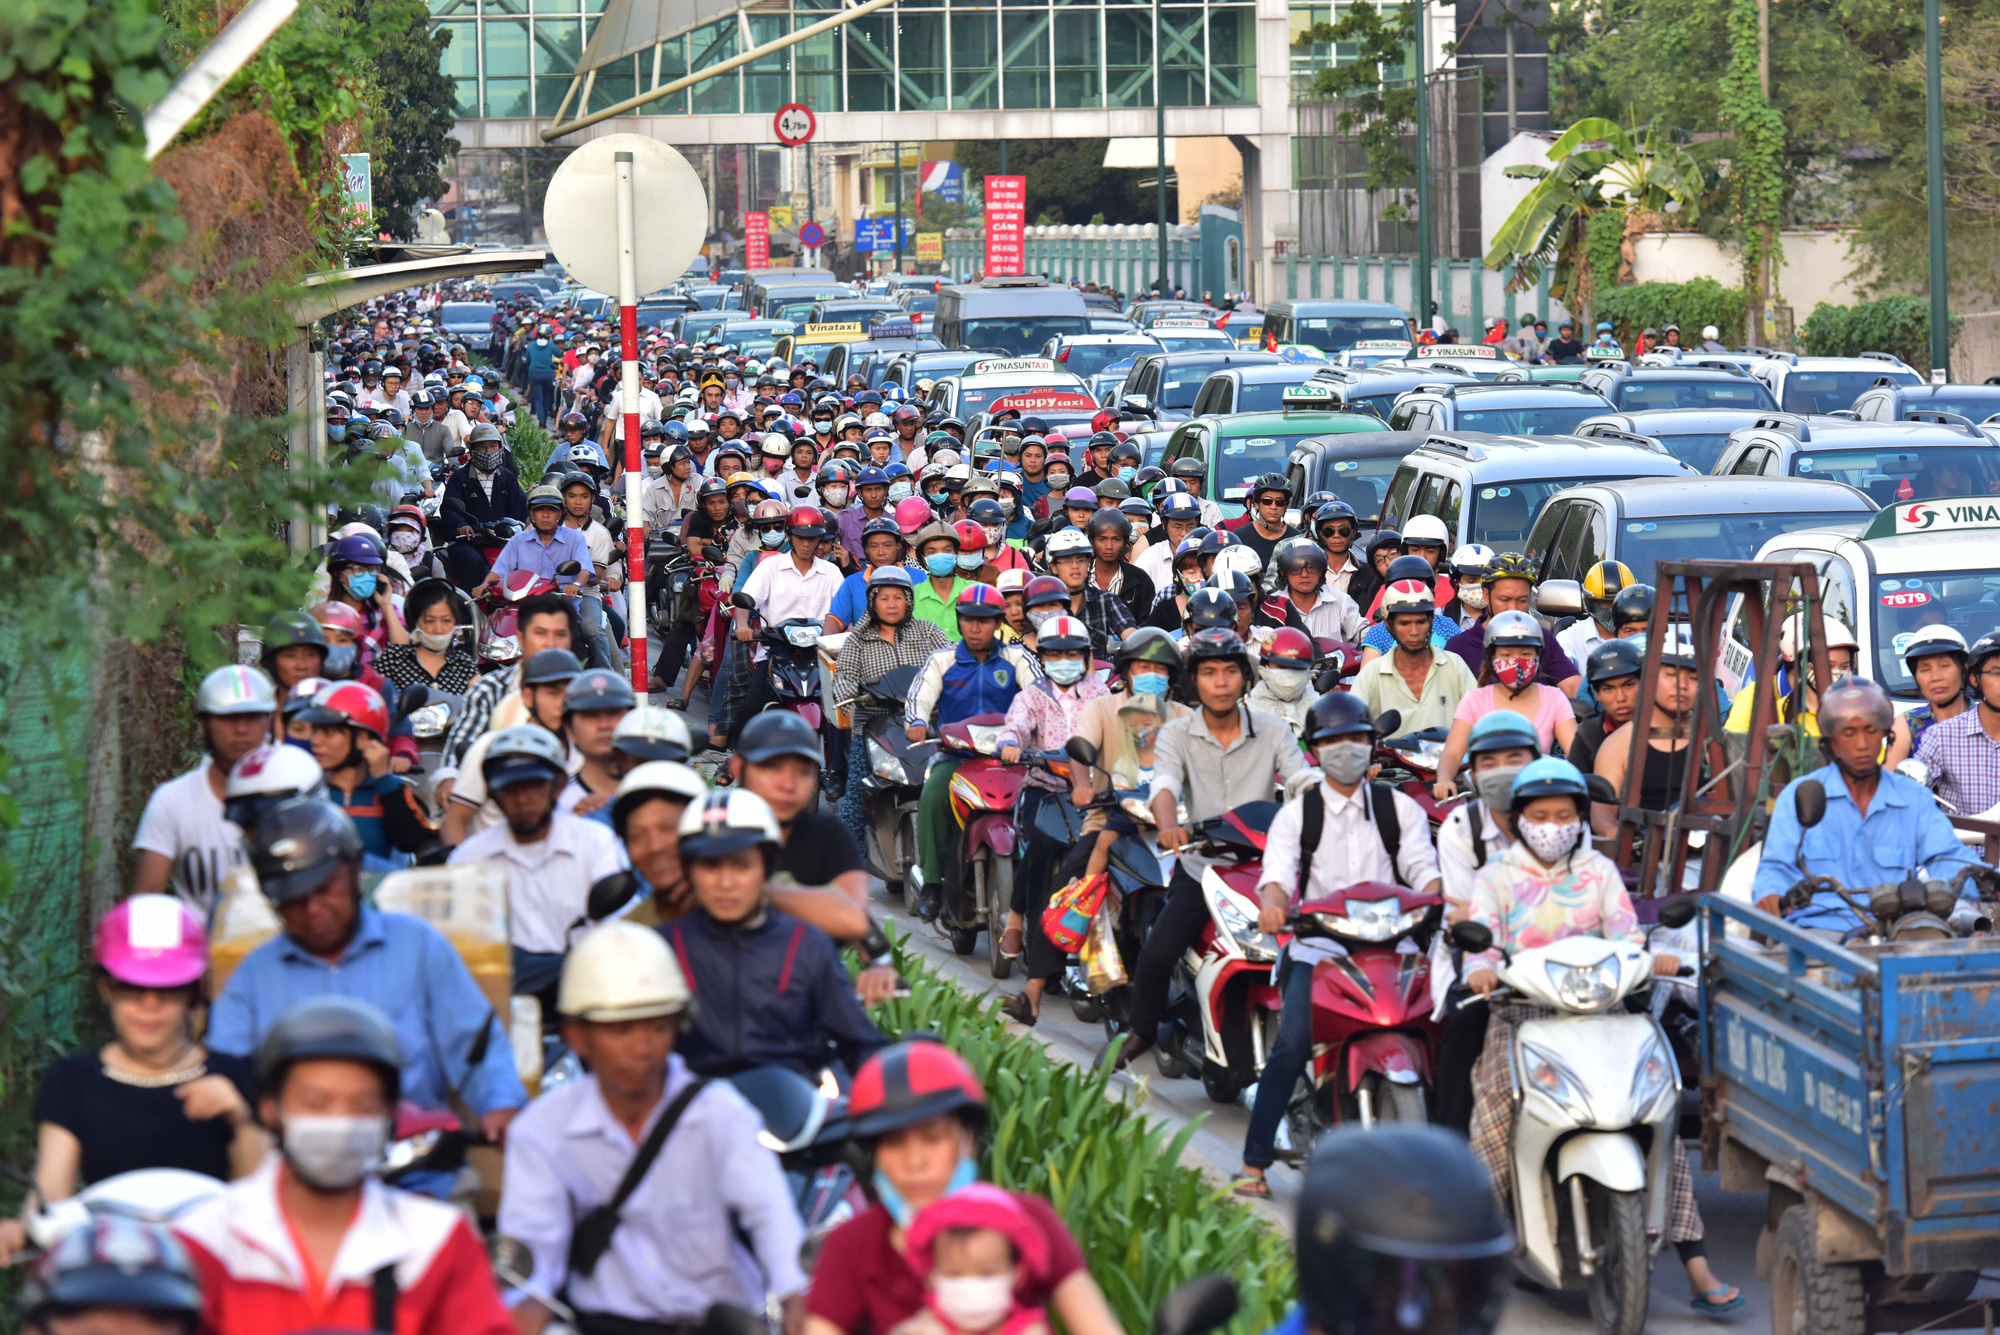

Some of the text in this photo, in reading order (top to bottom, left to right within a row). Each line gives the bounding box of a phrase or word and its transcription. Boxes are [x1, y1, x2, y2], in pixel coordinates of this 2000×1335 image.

[810, 323, 856, 332] Vinataxi
[1478, 349, 1495, 357] TAXI
[1003, 396, 1084, 408] happy taxi
[1884, 592, 1927, 605] 7679
